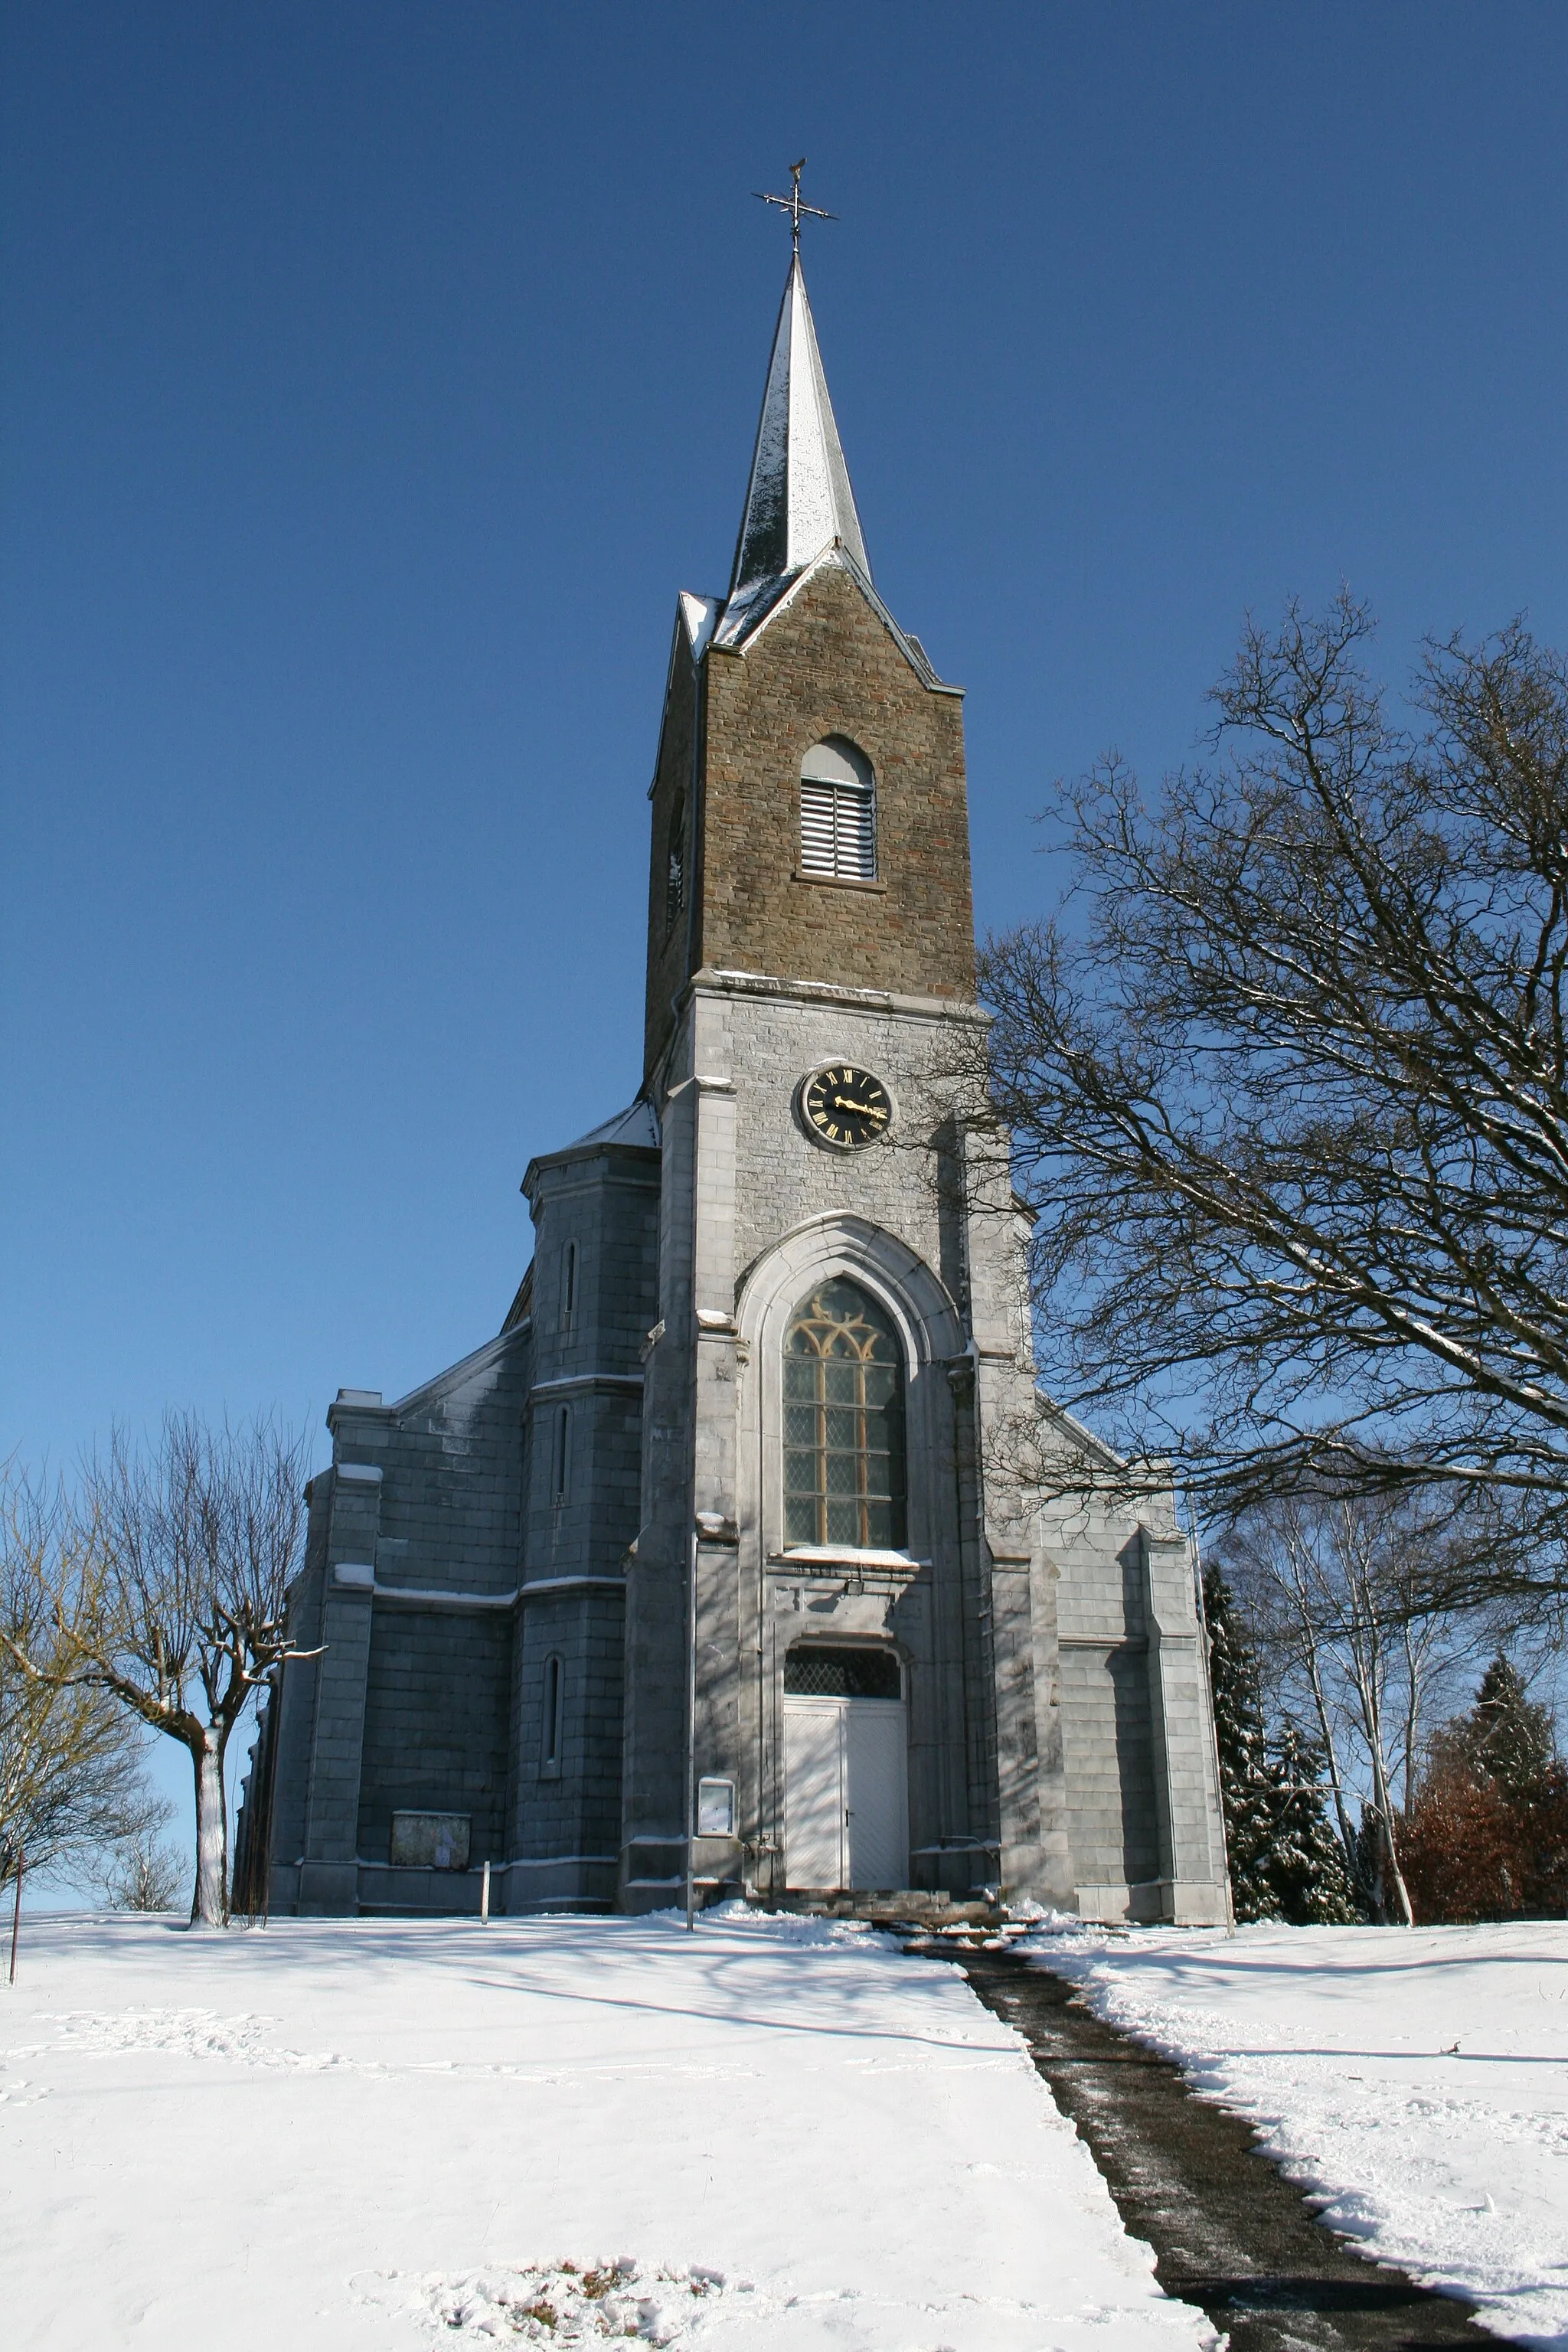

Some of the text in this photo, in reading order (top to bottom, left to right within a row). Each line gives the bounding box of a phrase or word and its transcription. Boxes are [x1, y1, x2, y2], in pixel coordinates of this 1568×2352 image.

[826, 1071, 838, 1086] XI
[843, 1069, 853, 1083] XII
[813, 1083, 827, 1094] X
[869, 1090, 882, 1099] II
[808, 1099, 823, 1108] IX
[812, 1111, 828, 1125] VIII
[826, 1123, 838, 1138] VII
[844, 1130, 853, 1144] VI
